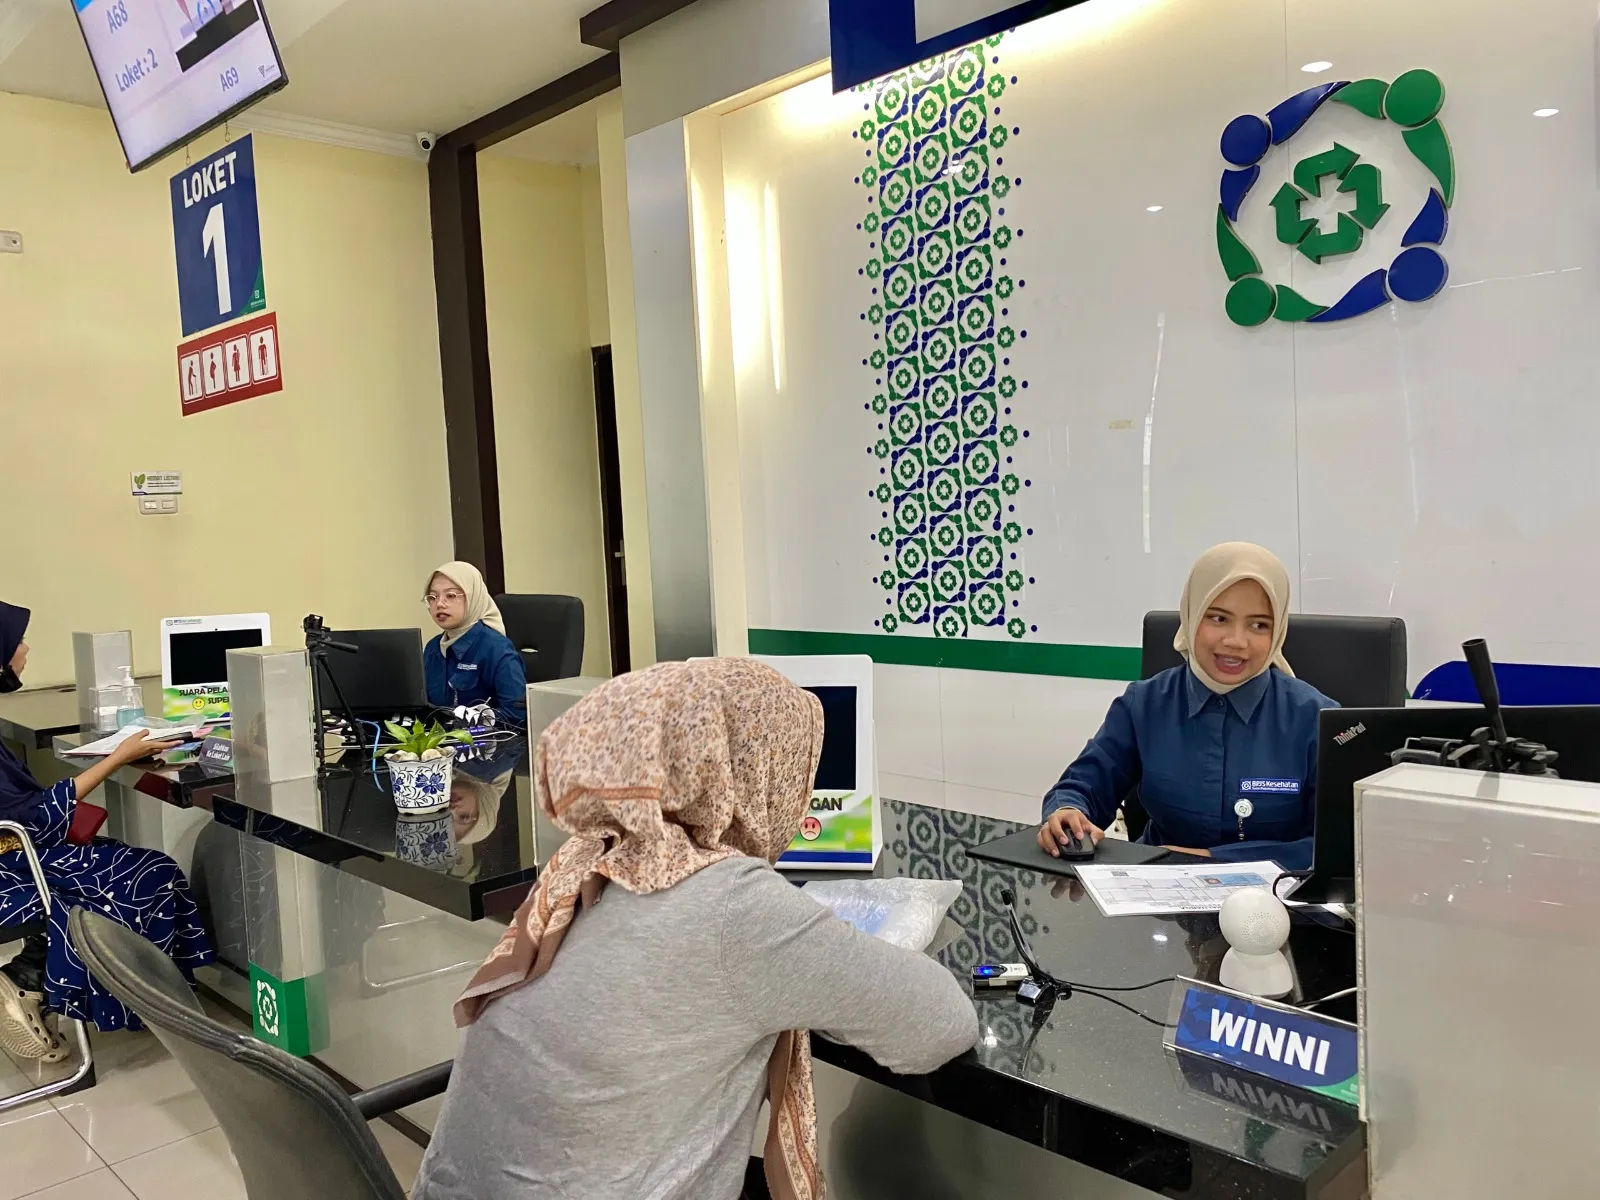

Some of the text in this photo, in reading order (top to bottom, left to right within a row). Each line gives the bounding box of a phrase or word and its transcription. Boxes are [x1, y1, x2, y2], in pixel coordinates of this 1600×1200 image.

[106, 0, 129, 33] A68
[115, 56, 142, 92] Loket
[147, 48, 159, 69] 2
[220, 66, 239, 91] A69
[182, 151, 237, 209] LOKET
[202, 202, 232, 315] 1
[179, 686, 229, 697] SUARA PELA
[1333, 721, 1367, 746] ThinkPad
[809, 797, 843, 811] GAN
[1210, 1008, 1331, 1076] WINNI
